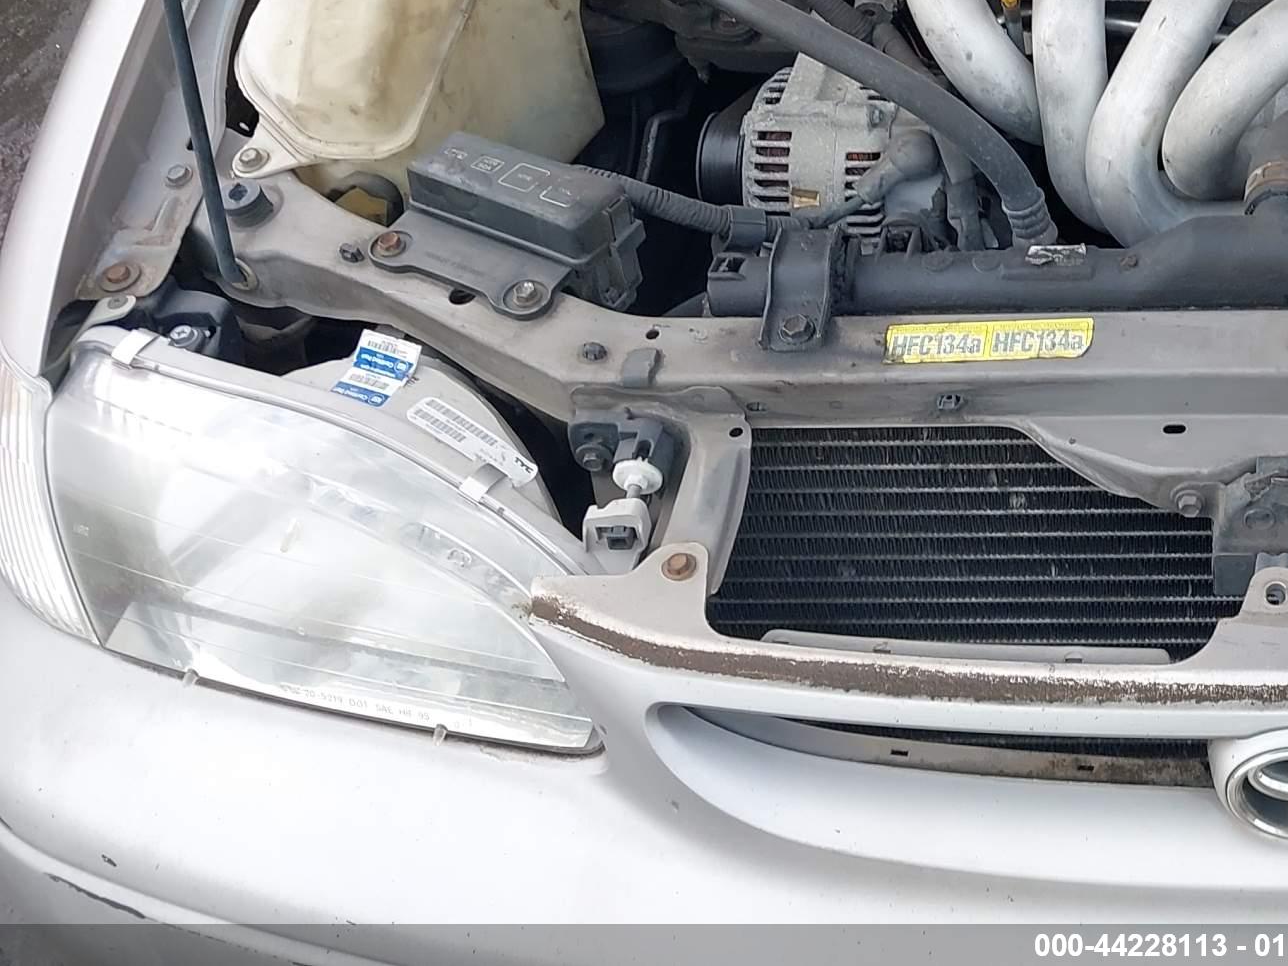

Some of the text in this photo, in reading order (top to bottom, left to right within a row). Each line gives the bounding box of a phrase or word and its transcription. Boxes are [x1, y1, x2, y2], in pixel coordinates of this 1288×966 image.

[891, 329, 1084, 356] HFC134a HFC134a
[515, 456, 534, 474] TYC
